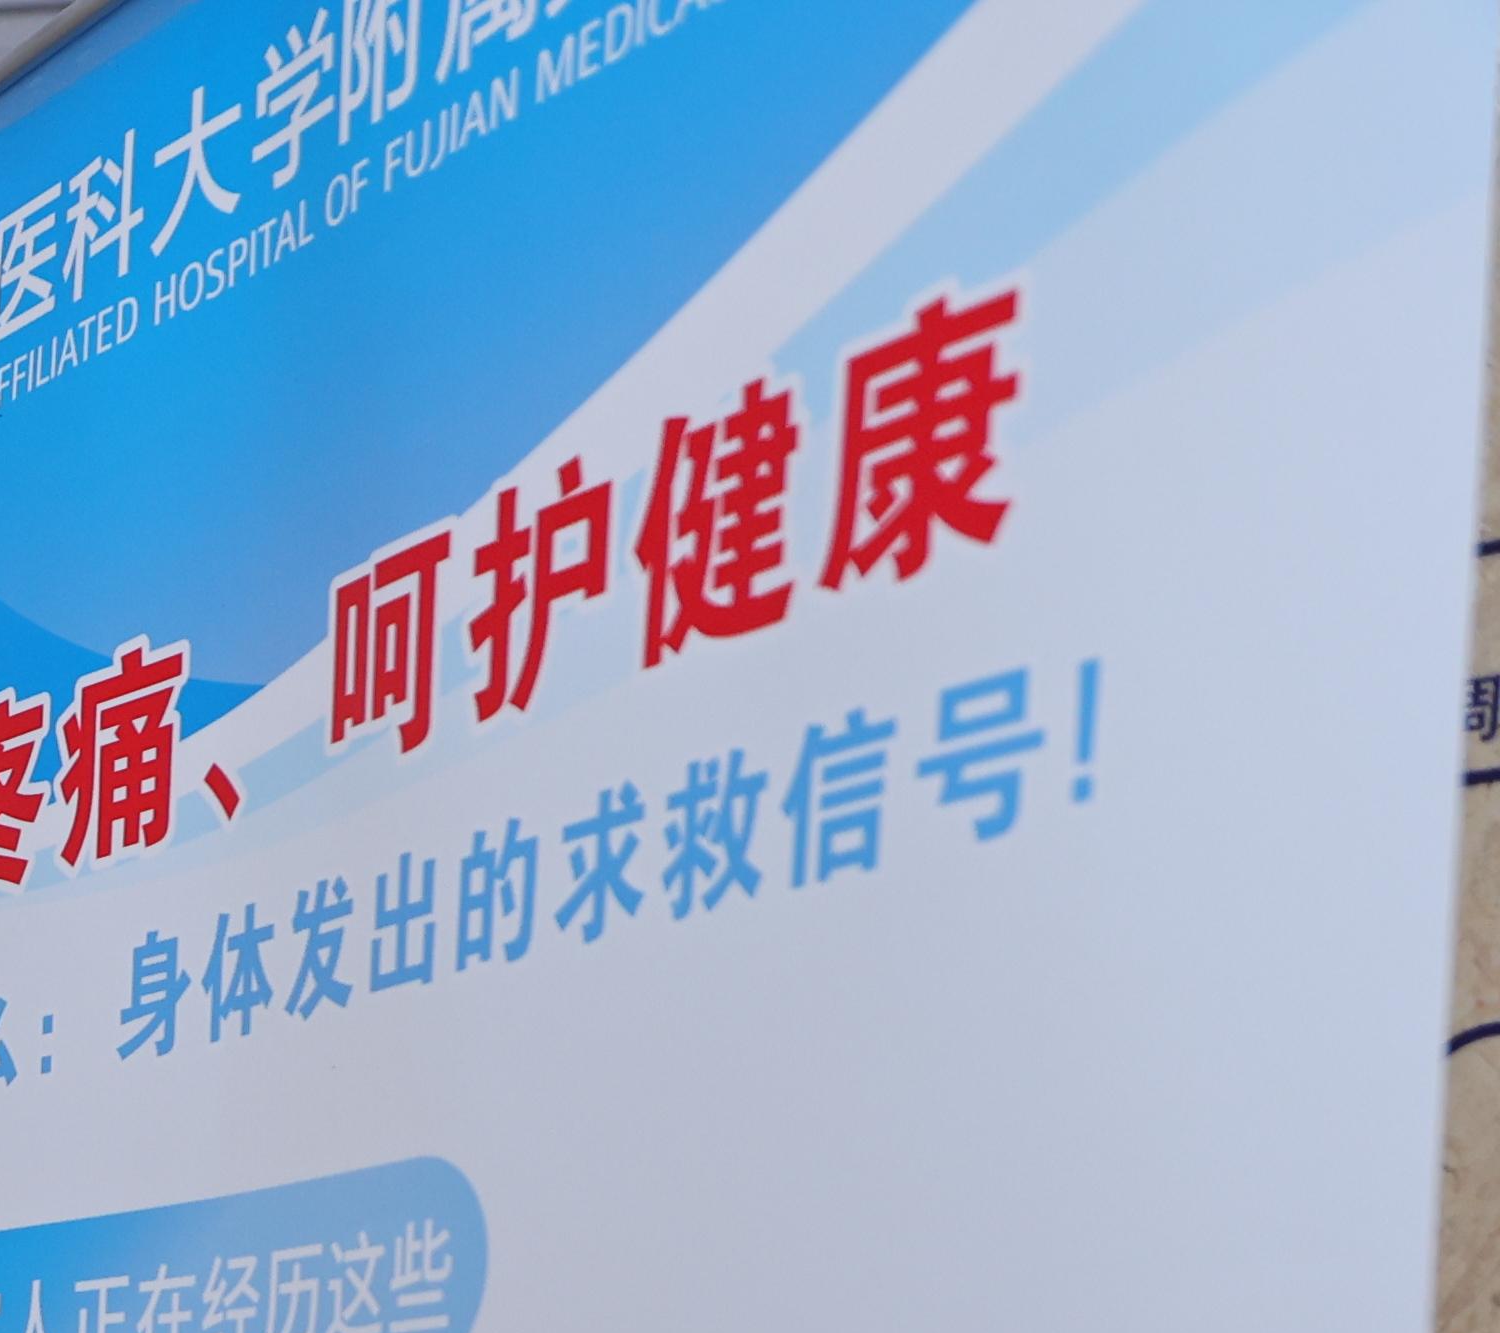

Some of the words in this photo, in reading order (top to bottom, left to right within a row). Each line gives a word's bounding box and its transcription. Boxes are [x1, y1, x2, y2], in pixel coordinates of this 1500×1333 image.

[152, 204, 316, 328] HOSPITAL
[324, 160, 370, 227] OF
[383, 65, 520, 180] FUJIAN
